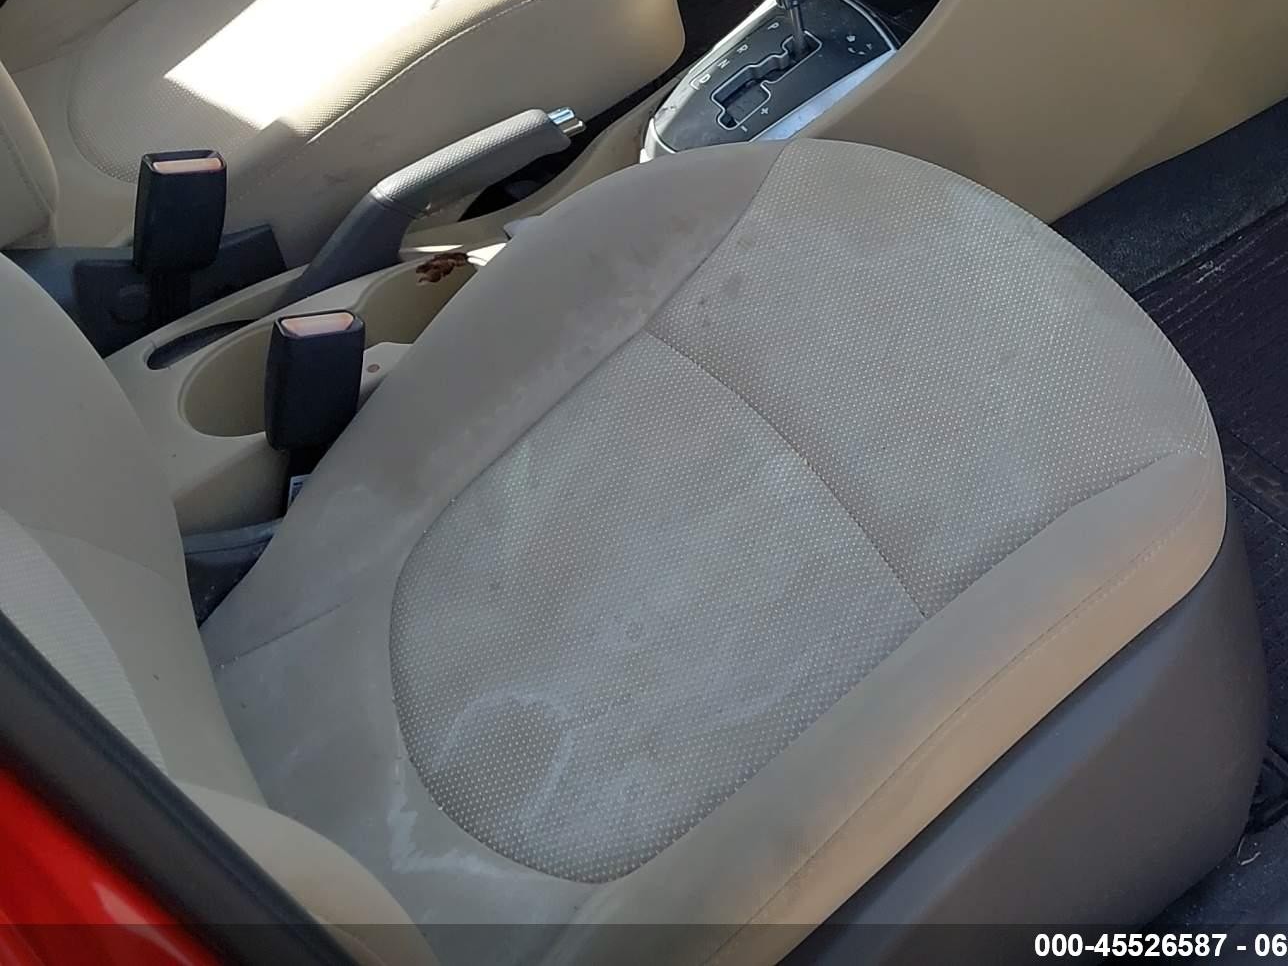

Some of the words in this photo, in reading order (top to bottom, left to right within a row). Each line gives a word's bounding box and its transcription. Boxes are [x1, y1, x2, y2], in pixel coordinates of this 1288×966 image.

[767, 22, 779, 30] P
[736, 44, 748, 54] R
[717, 58, 730, 69] N
[699, 73, 711, 84] D
